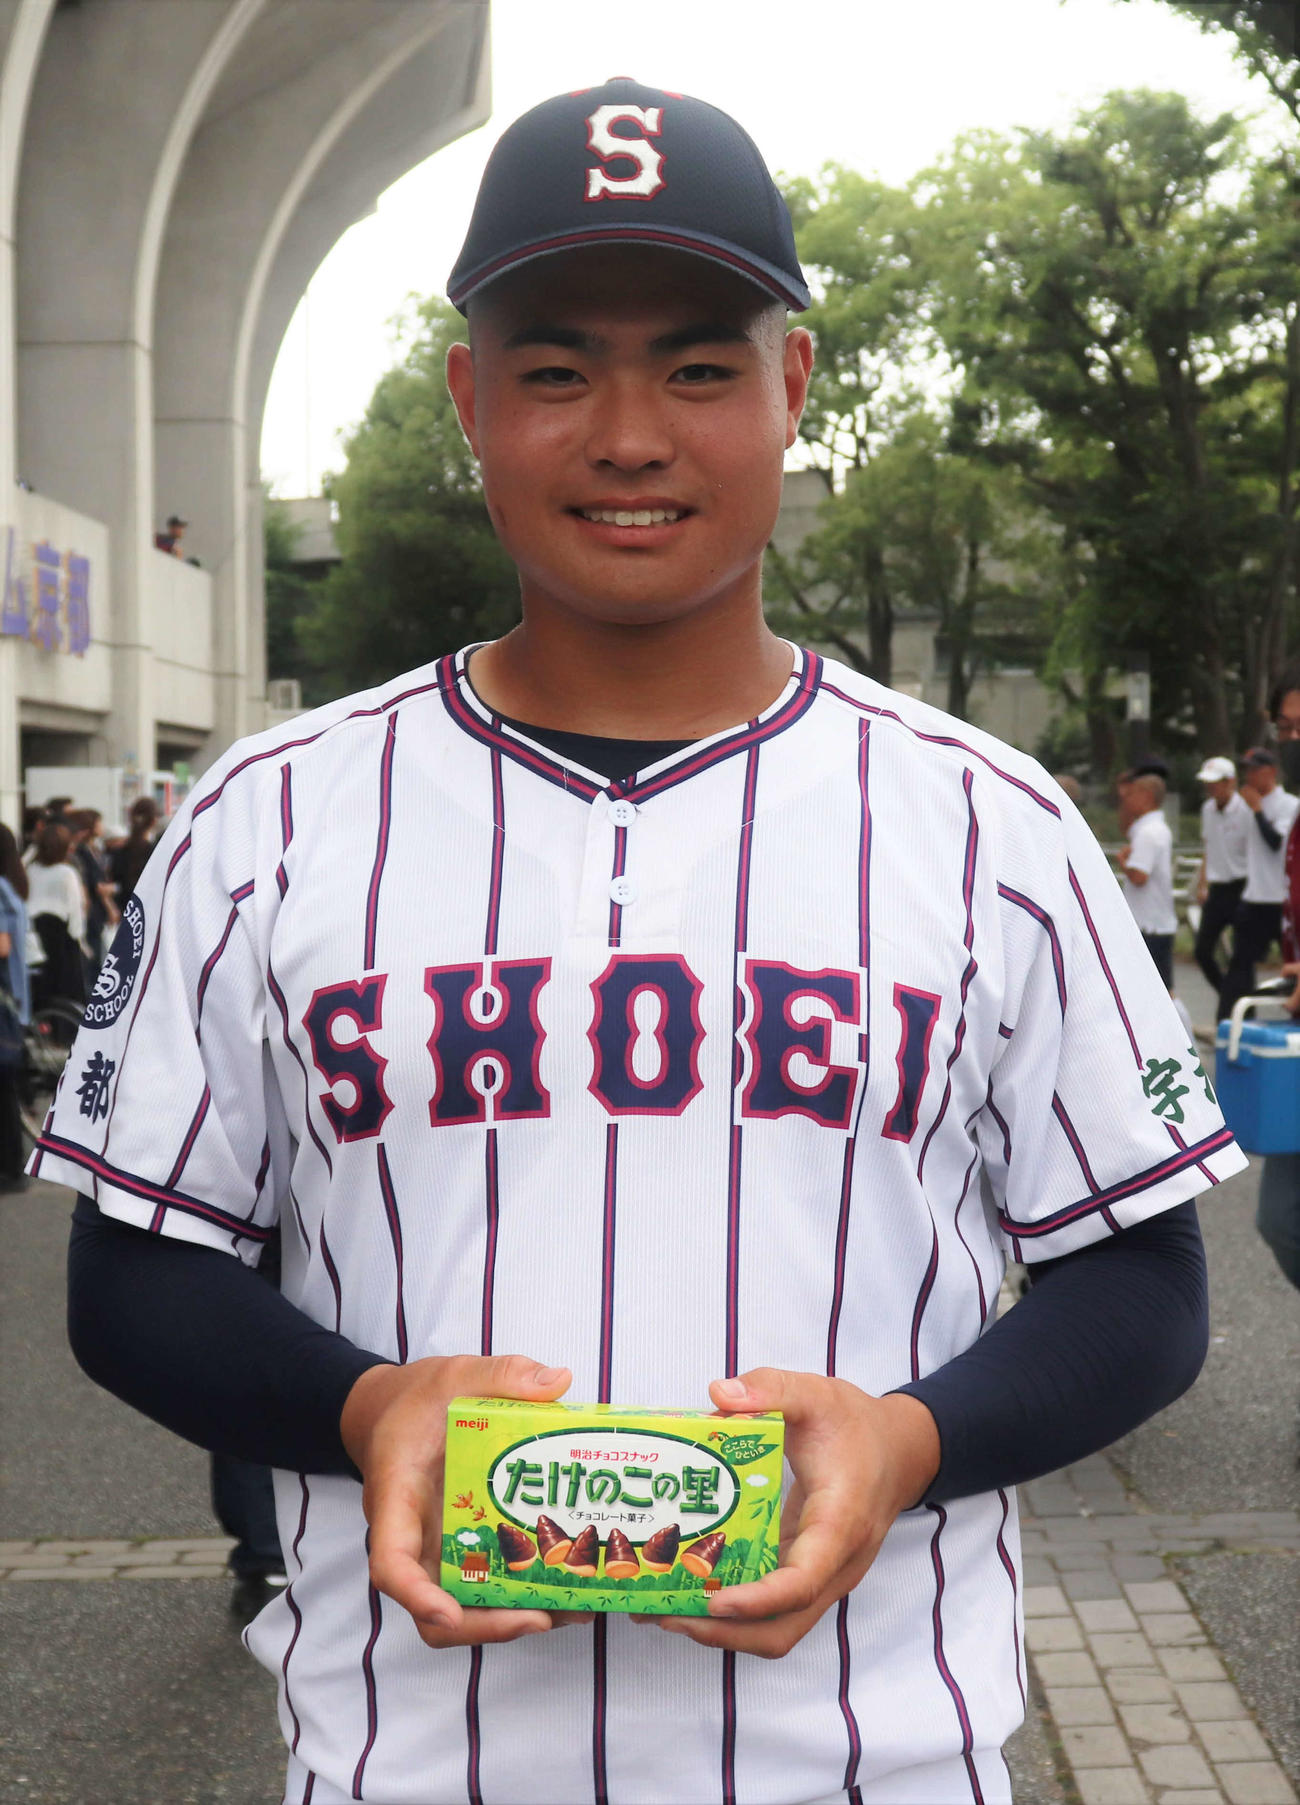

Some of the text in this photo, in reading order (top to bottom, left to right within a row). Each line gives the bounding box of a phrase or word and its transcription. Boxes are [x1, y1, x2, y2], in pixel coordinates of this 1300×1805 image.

[584, 104, 667, 202] S
[123, 900, 143, 958] SHOEI
[85, 975, 134, 1022] SCHOOL
[302, 953, 941, 1144] SHOEI
[75, 1051, 115, 1125] 都
[1142, 1047, 1216, 1124] 宇
[456, 1418, 489, 1431] meiji
[724, 1440, 755, 1453] ここらで
[569, 1448, 659, 1463] 明治チョコスナック
[502, 1458, 719, 1515] たけのこの里
